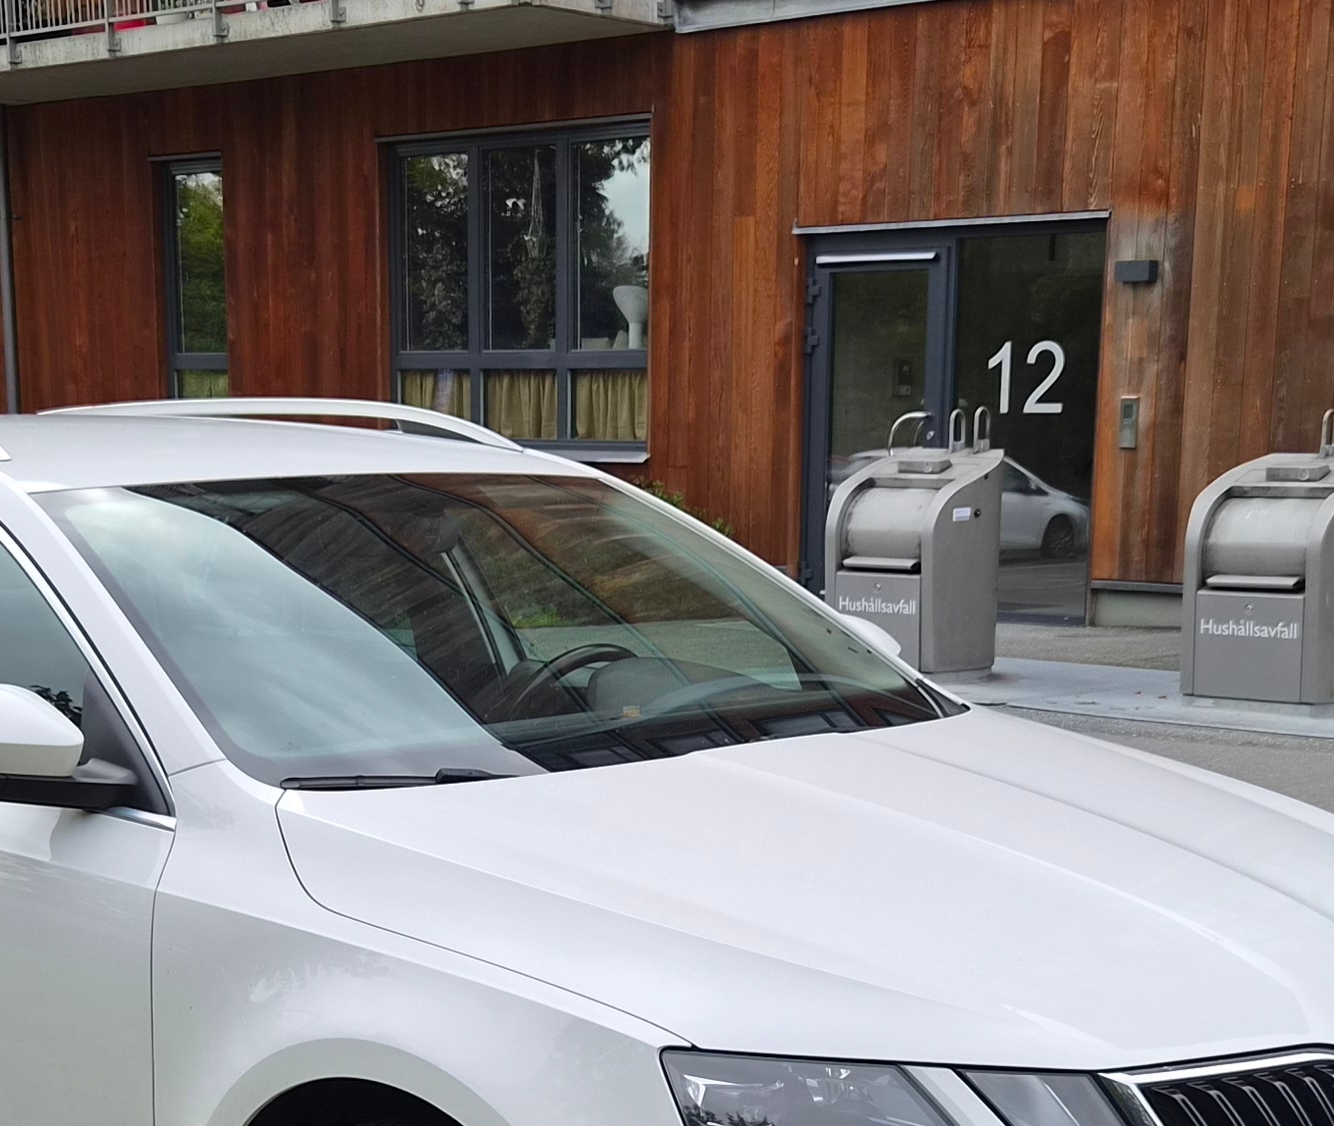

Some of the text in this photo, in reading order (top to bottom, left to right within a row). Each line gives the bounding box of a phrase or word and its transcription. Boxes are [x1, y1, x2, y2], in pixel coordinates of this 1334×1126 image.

[987, 340, 1065, 414] 12
[838, 596, 916, 615] Hushållsavfall
[1200, 618, 1298, 639] Hushållsavfall
